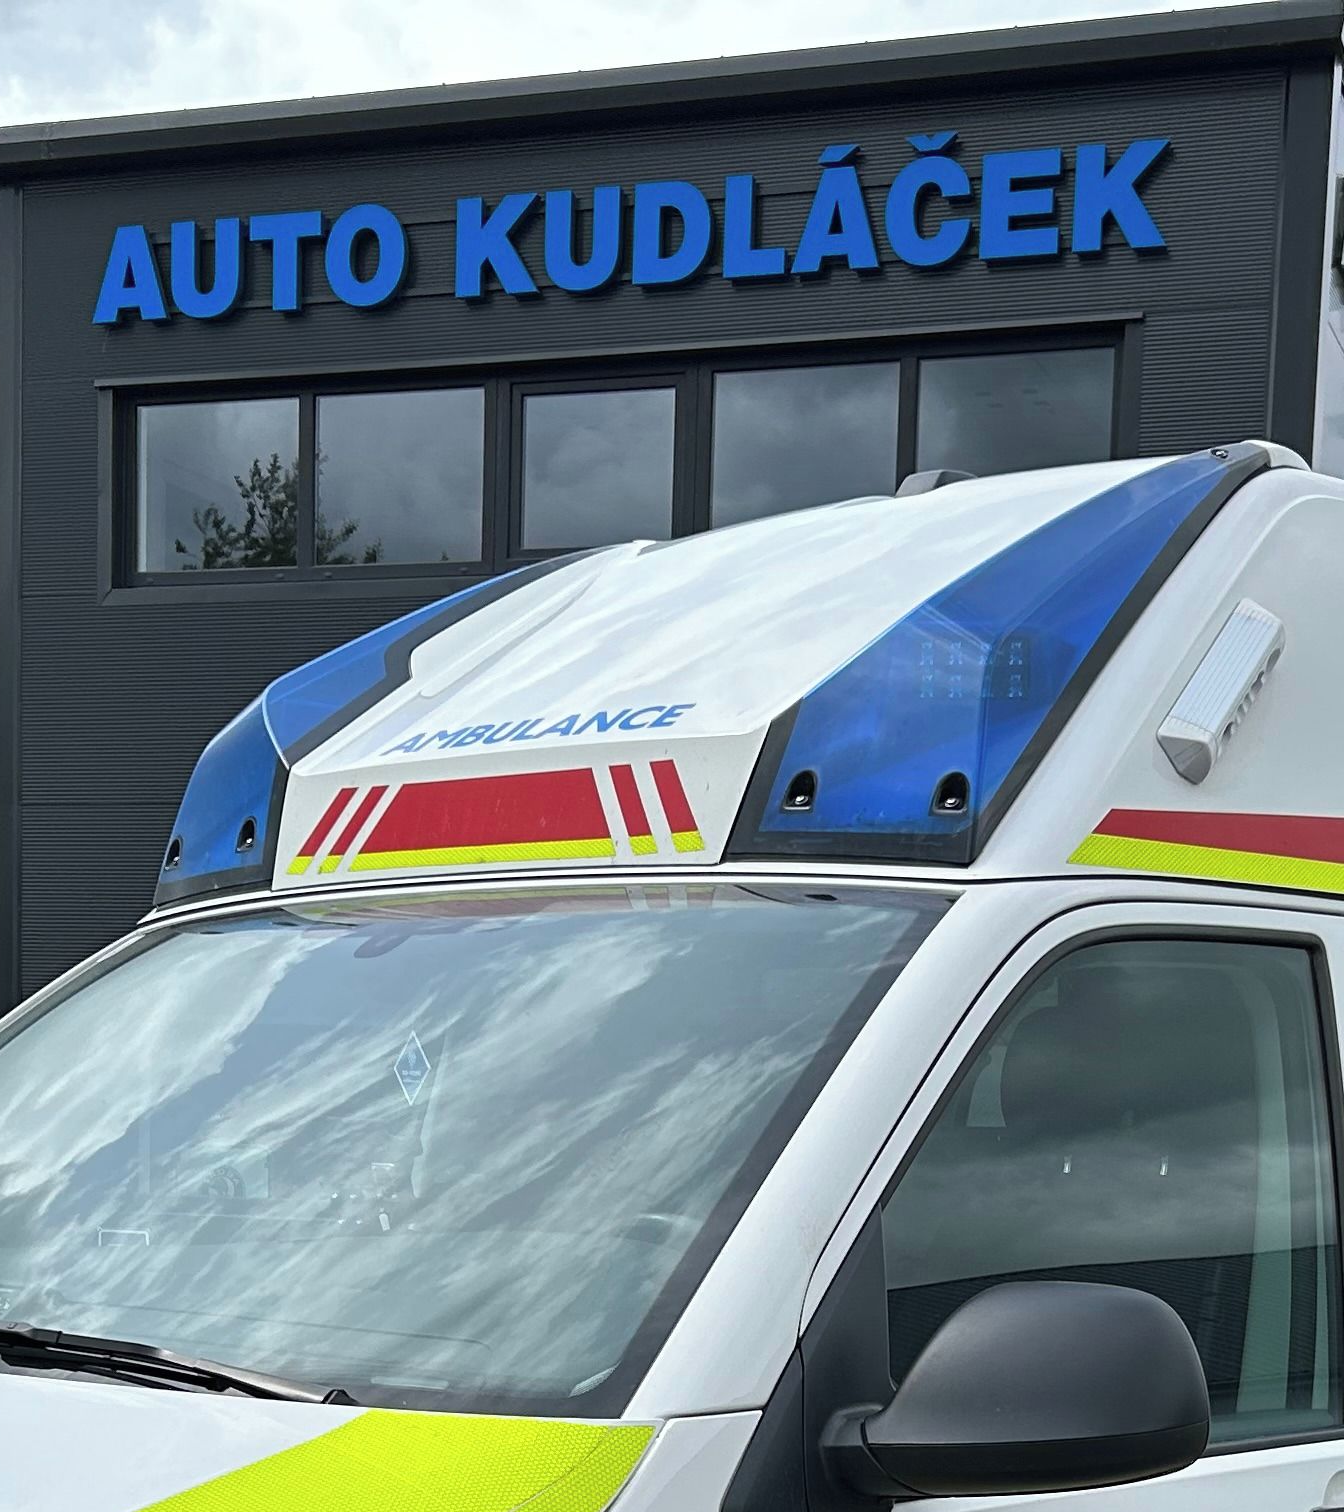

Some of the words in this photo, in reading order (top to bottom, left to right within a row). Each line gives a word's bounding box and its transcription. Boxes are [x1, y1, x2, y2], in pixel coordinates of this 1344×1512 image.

[92, 203, 407, 326] AUTO
[453, 131, 1171, 300] KUDLÁČEK
[379, 702, 697, 757] AMBULANCE
